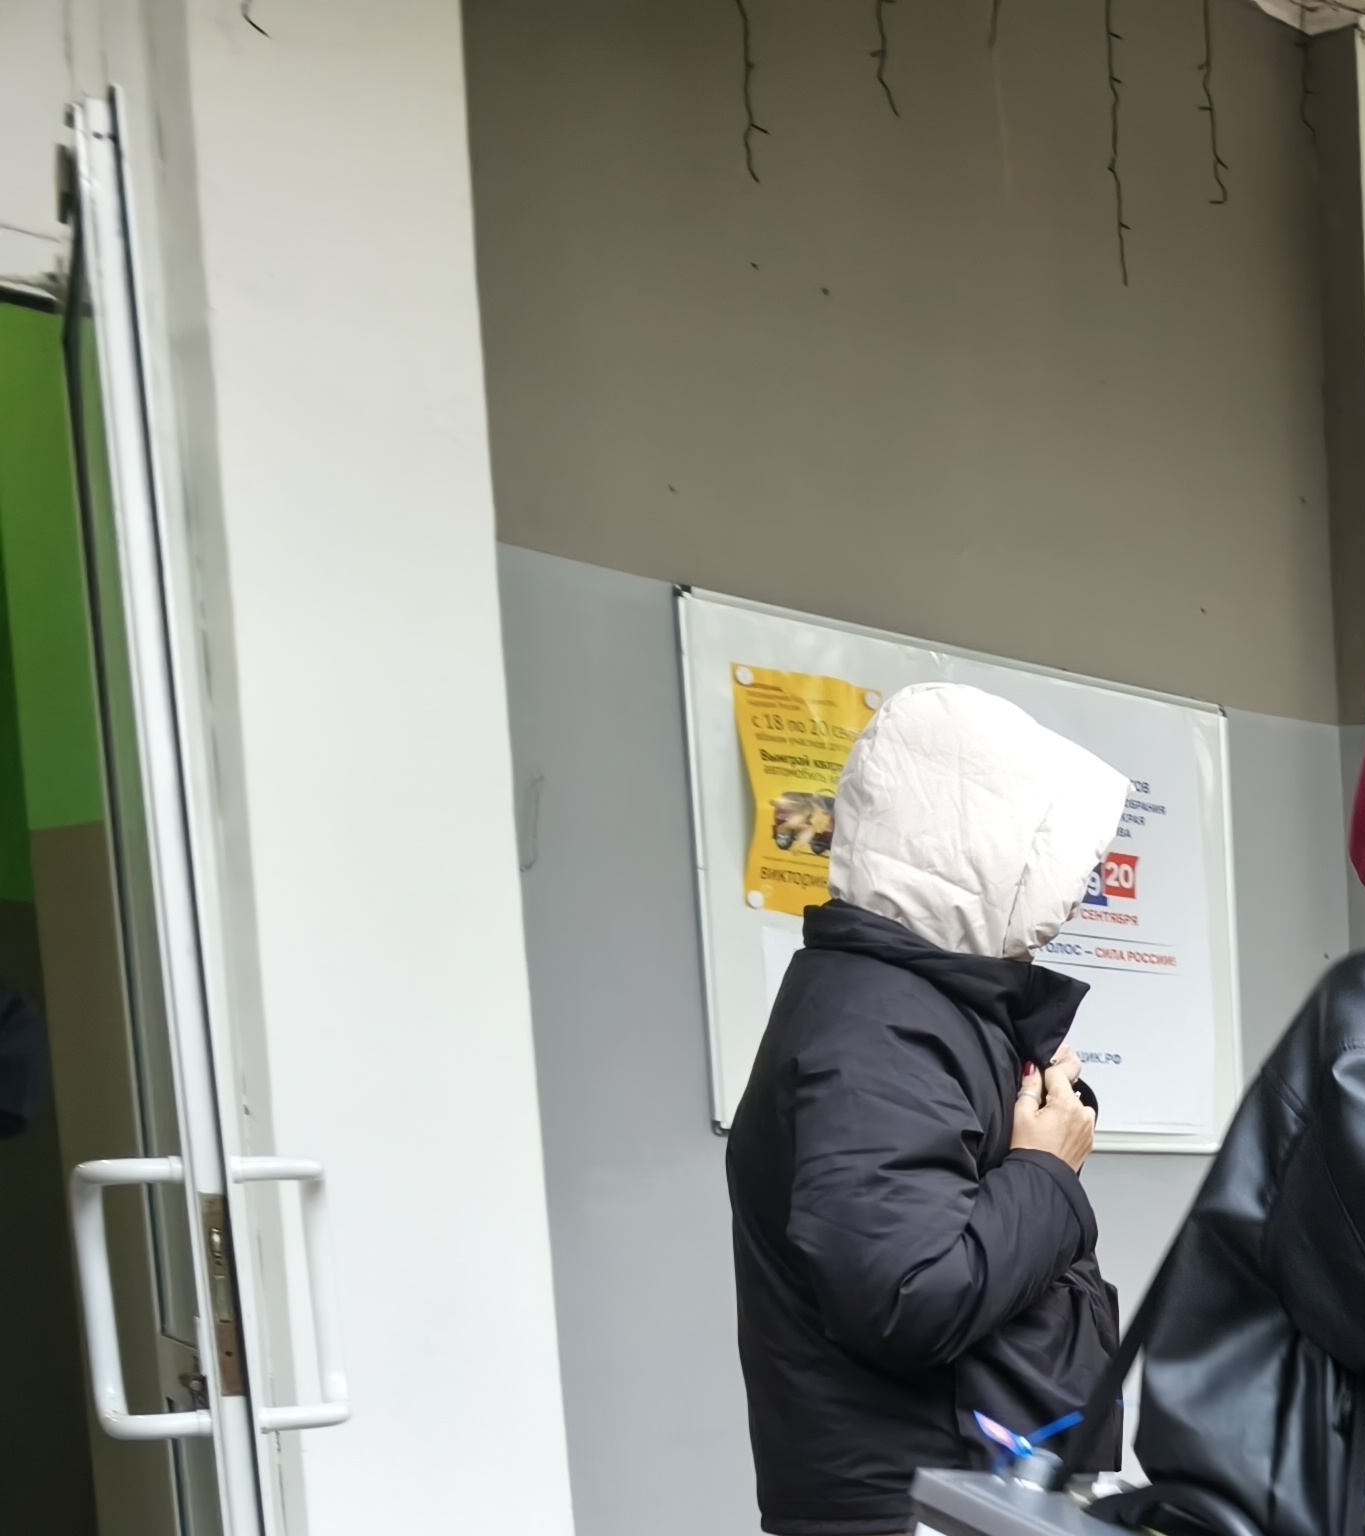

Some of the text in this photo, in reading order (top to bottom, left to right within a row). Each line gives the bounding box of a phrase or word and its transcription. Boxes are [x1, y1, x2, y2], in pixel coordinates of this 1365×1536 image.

[763, 713, 784, 731] 18
[1105, 861, 1134, 890] 20
[1080, 908, 1139, 927] СЕНТЯБРЯ
[1095, 946, 1125, 961] СИЛА
